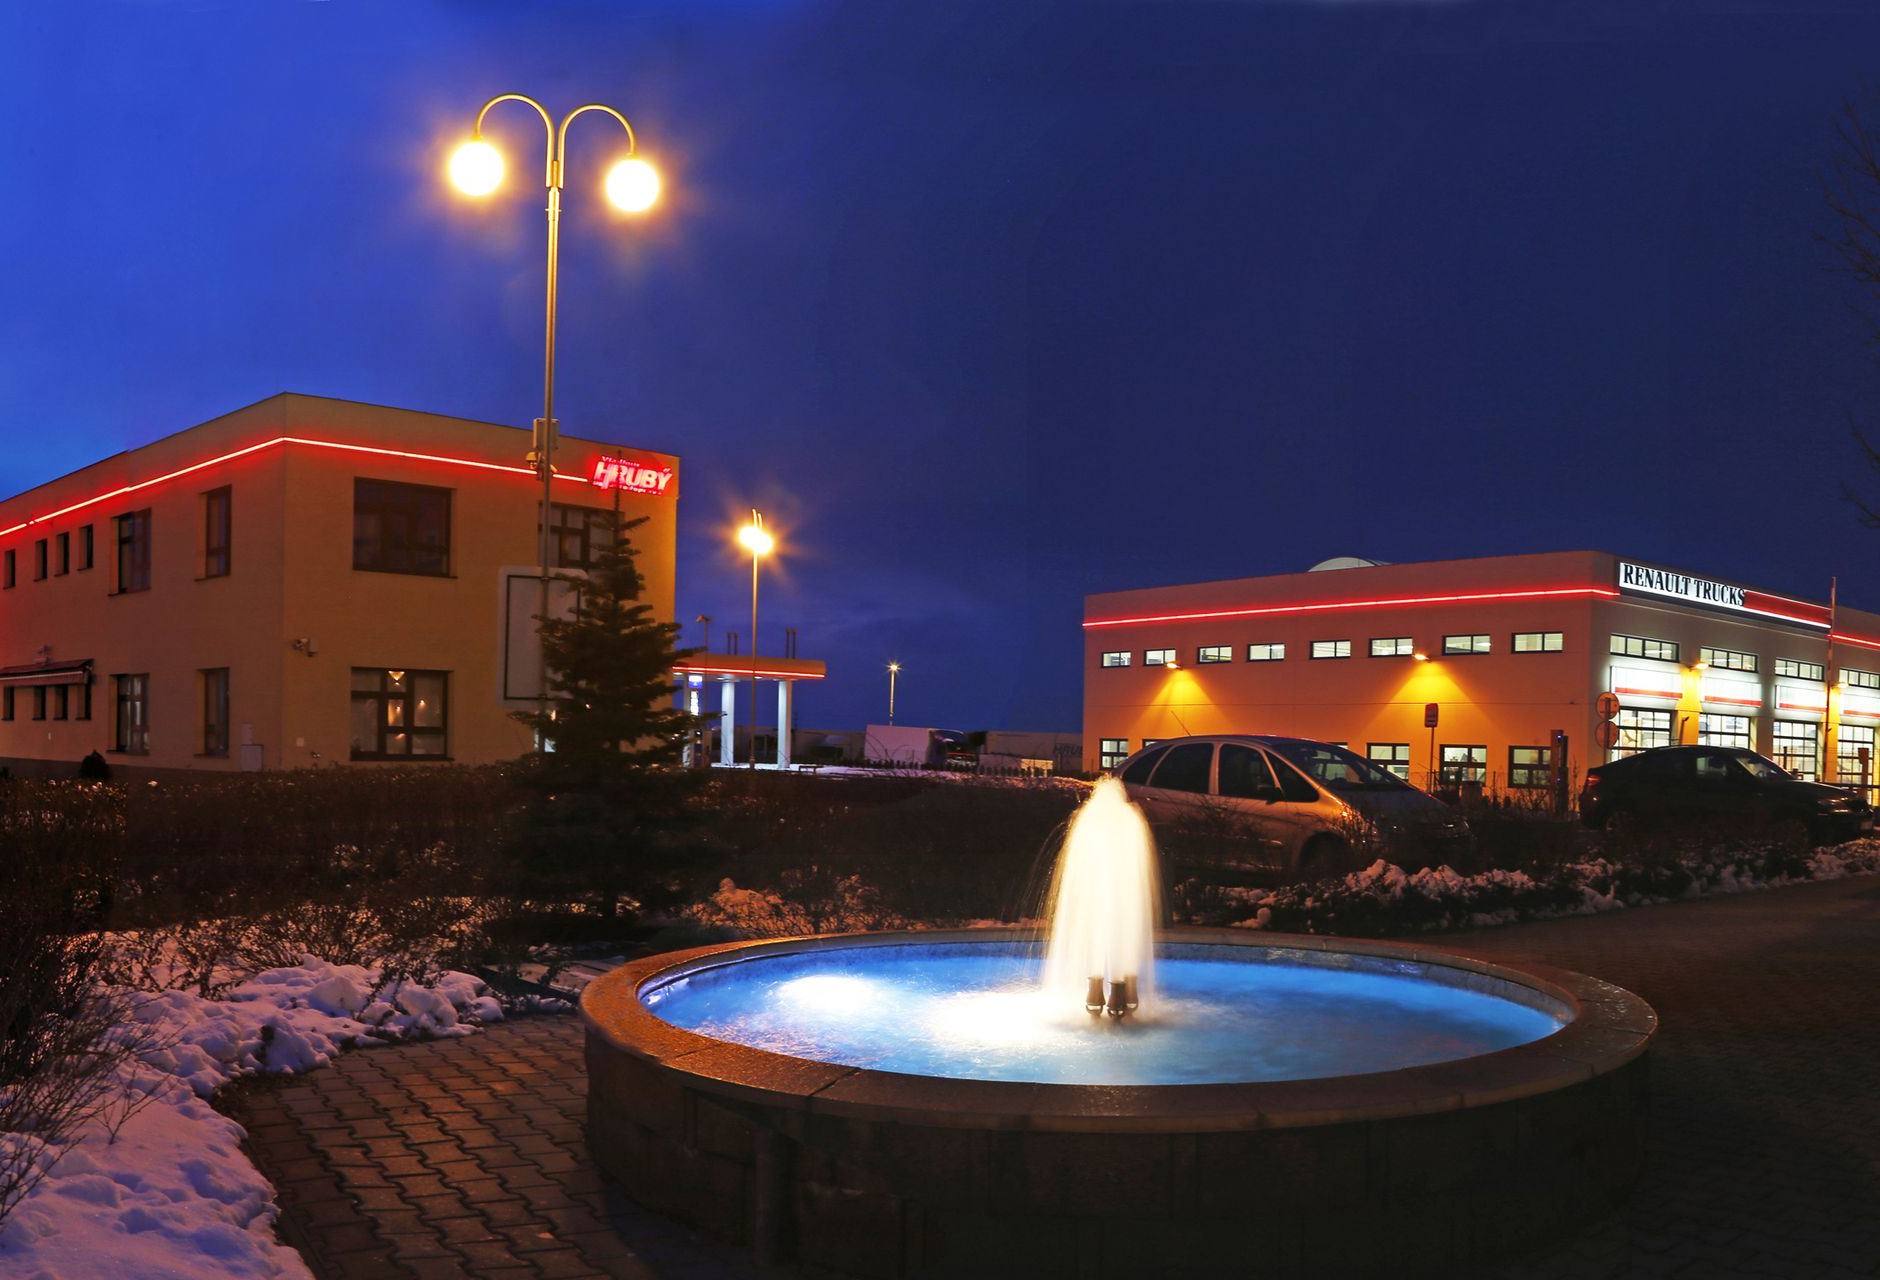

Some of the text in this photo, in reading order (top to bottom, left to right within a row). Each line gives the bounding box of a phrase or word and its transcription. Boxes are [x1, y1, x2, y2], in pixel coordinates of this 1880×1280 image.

[593, 461, 672, 490] HRUBÝ
[1623, 563, 1745, 607] RENAULT TRUCKS
